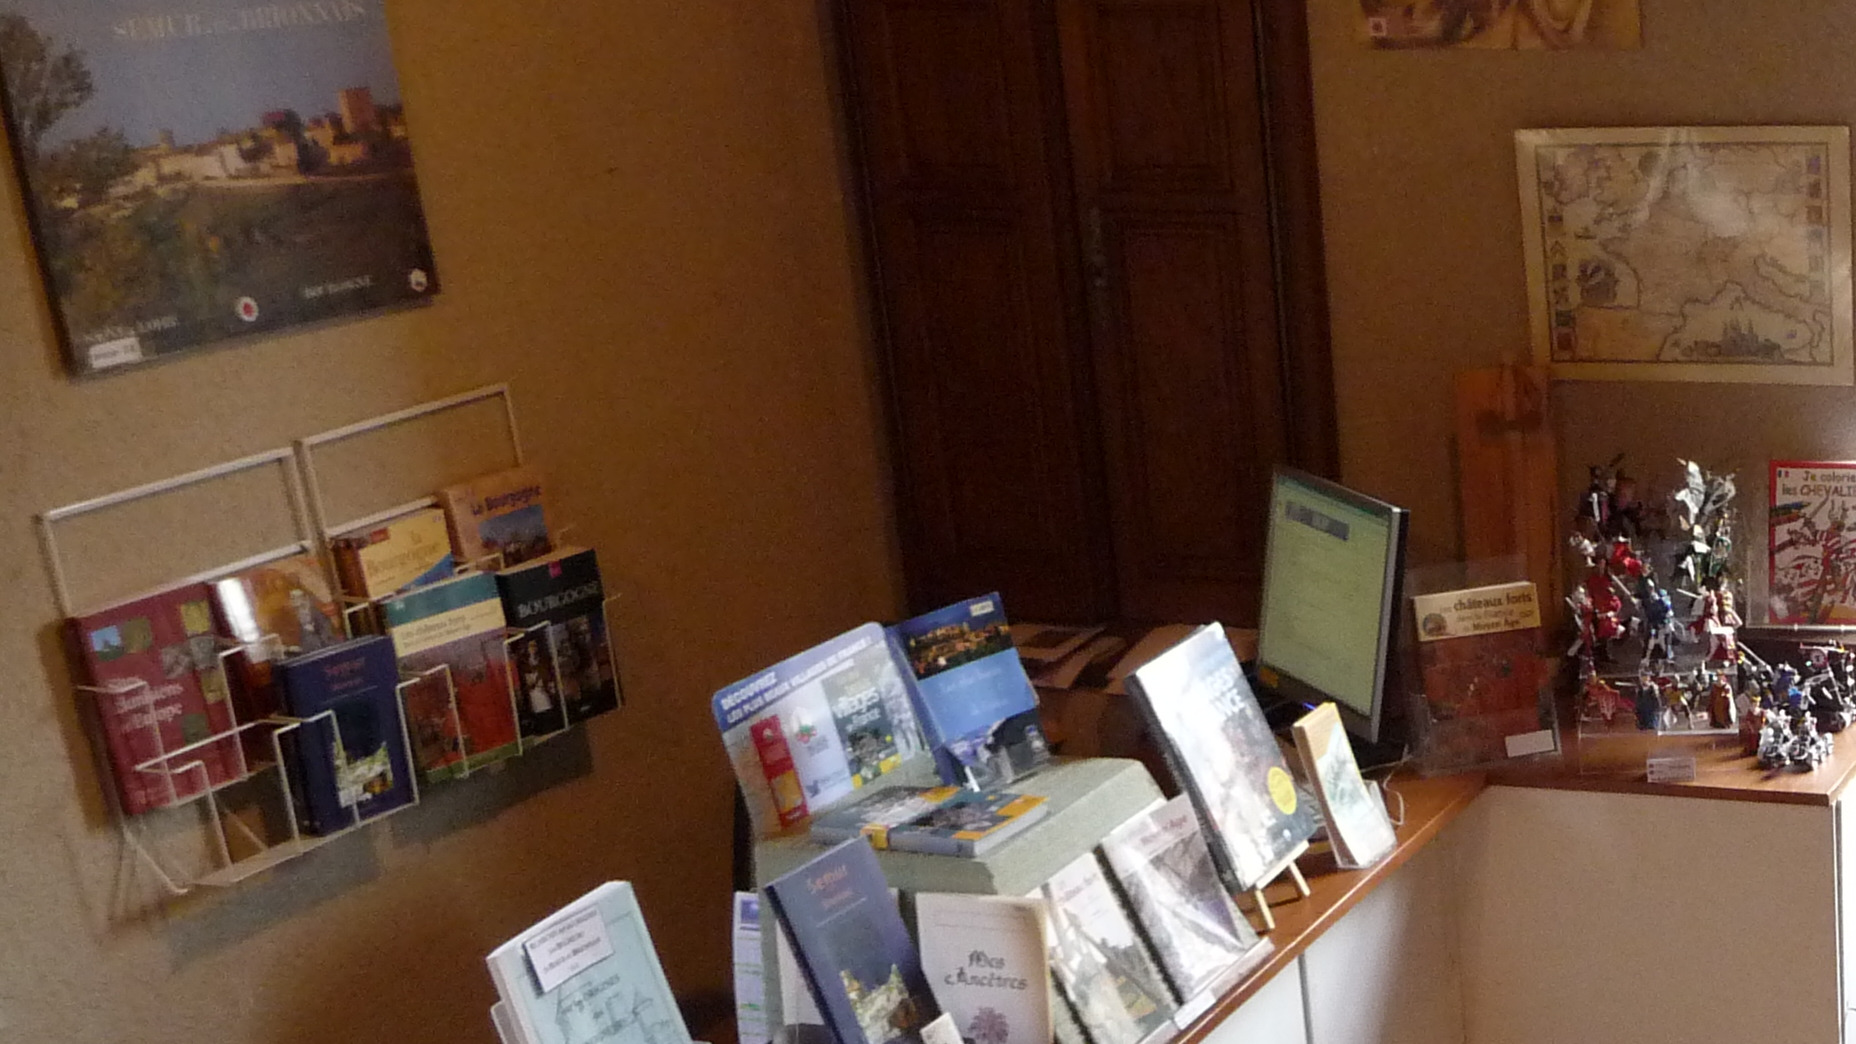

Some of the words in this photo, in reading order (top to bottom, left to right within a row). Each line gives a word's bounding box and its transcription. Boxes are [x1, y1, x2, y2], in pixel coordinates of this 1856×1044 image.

[1801, 470, 1817, 482] Je
[1820, 471, 1856, 483] colorie
[1782, 484, 1797, 496] les
